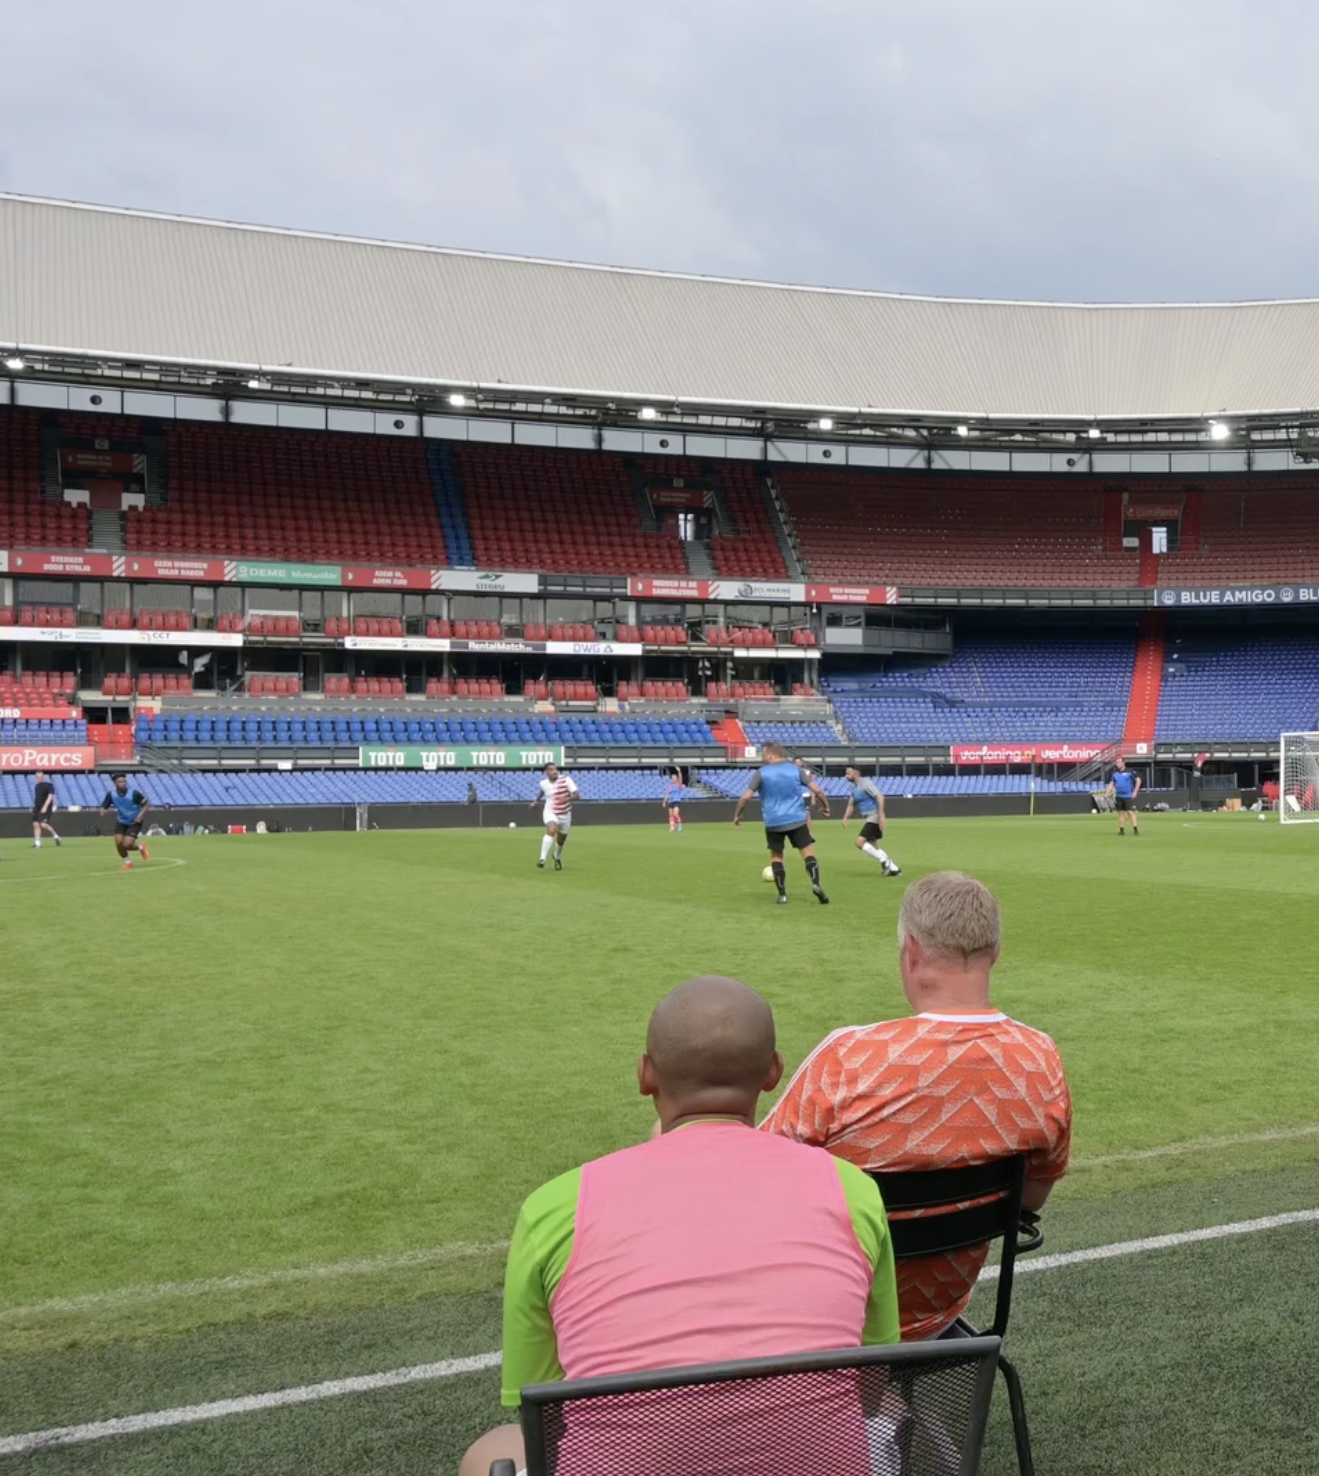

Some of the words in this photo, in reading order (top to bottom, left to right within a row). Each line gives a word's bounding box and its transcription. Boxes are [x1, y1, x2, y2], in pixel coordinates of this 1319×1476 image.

[250, 568, 286, 578] DEME
[291, 570, 338, 579] bluewater
[1181, 591, 1222, 604] BLUE
[1223, 590, 1275, 603] AMIGO
[153, 632, 170, 640] CCT
[573, 644, 600, 653] DWG
[369, 751, 405, 766] TOTO
[420, 751, 456, 766] TOTO
[471, 751, 506, 766] TOTO
[520, 751, 555, 765] TOTO
